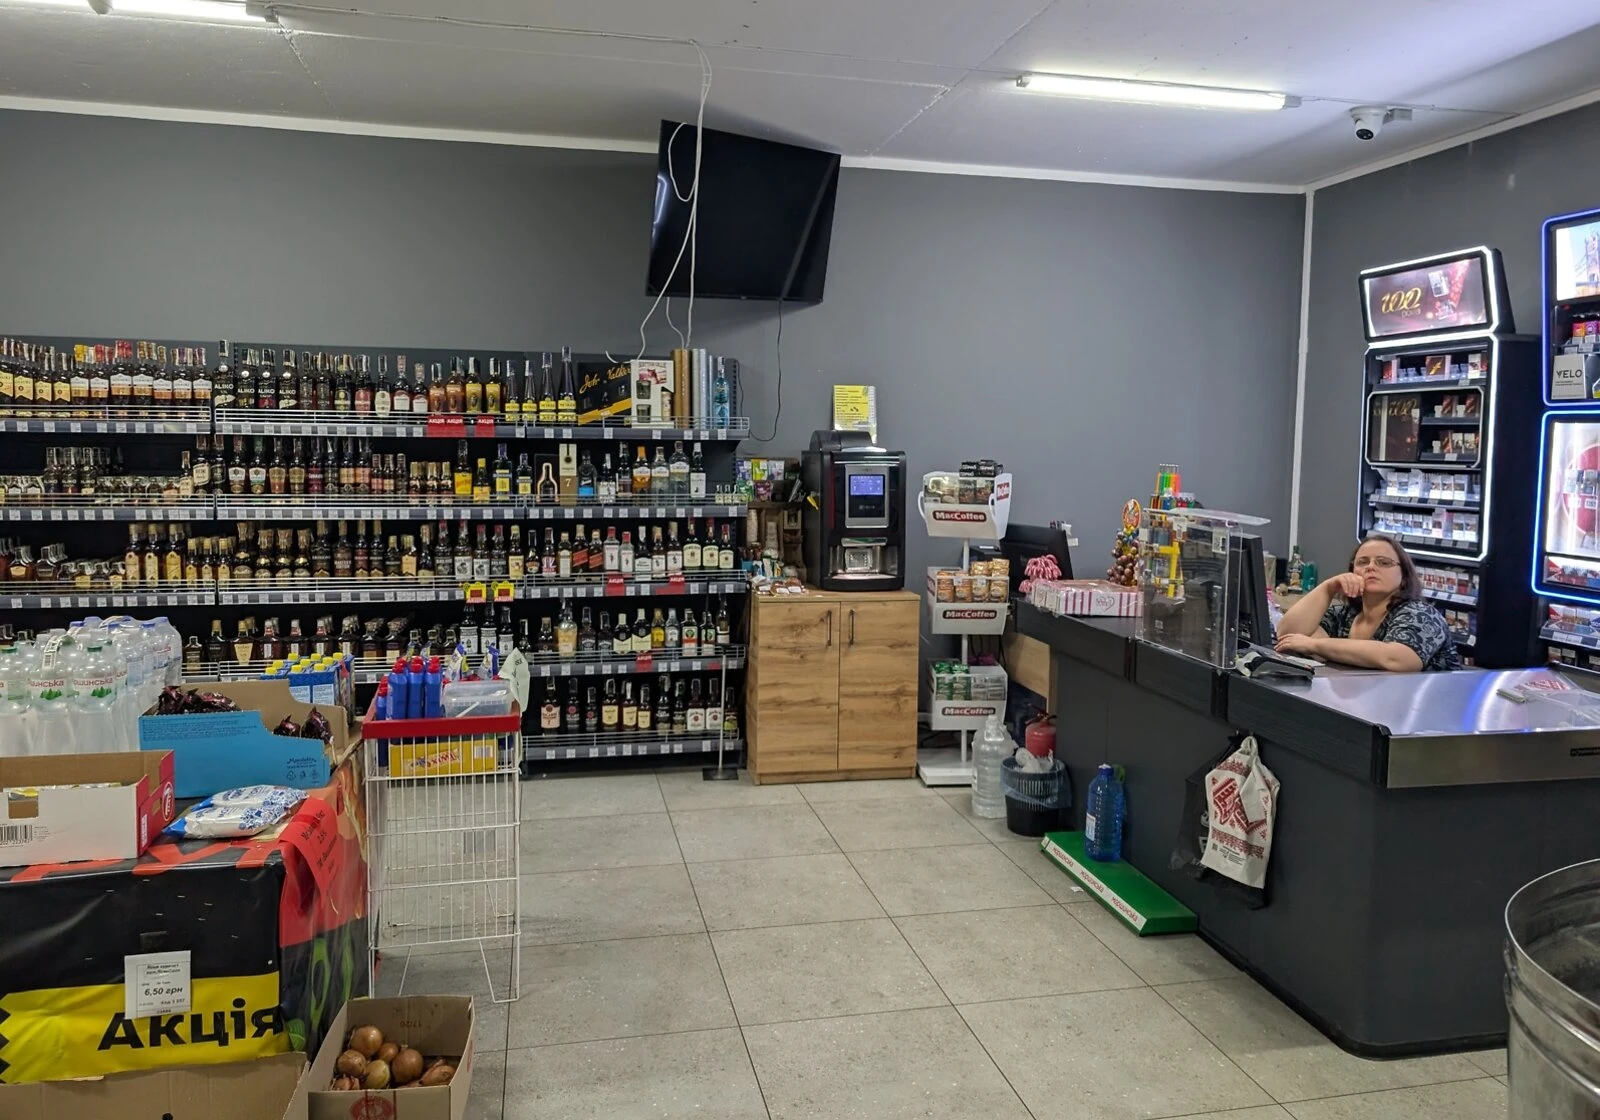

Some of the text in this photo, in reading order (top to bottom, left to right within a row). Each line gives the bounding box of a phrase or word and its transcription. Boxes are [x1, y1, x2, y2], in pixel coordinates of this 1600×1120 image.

[1556, 369, 1583, 378] VELO
[935, 511, 985, 521] MacCoffee
[945, 610, 995, 618] MacCoffee
[944, 707, 994, 716] MacCoffee
[144, 987, 184, 997] 6,50 грн
